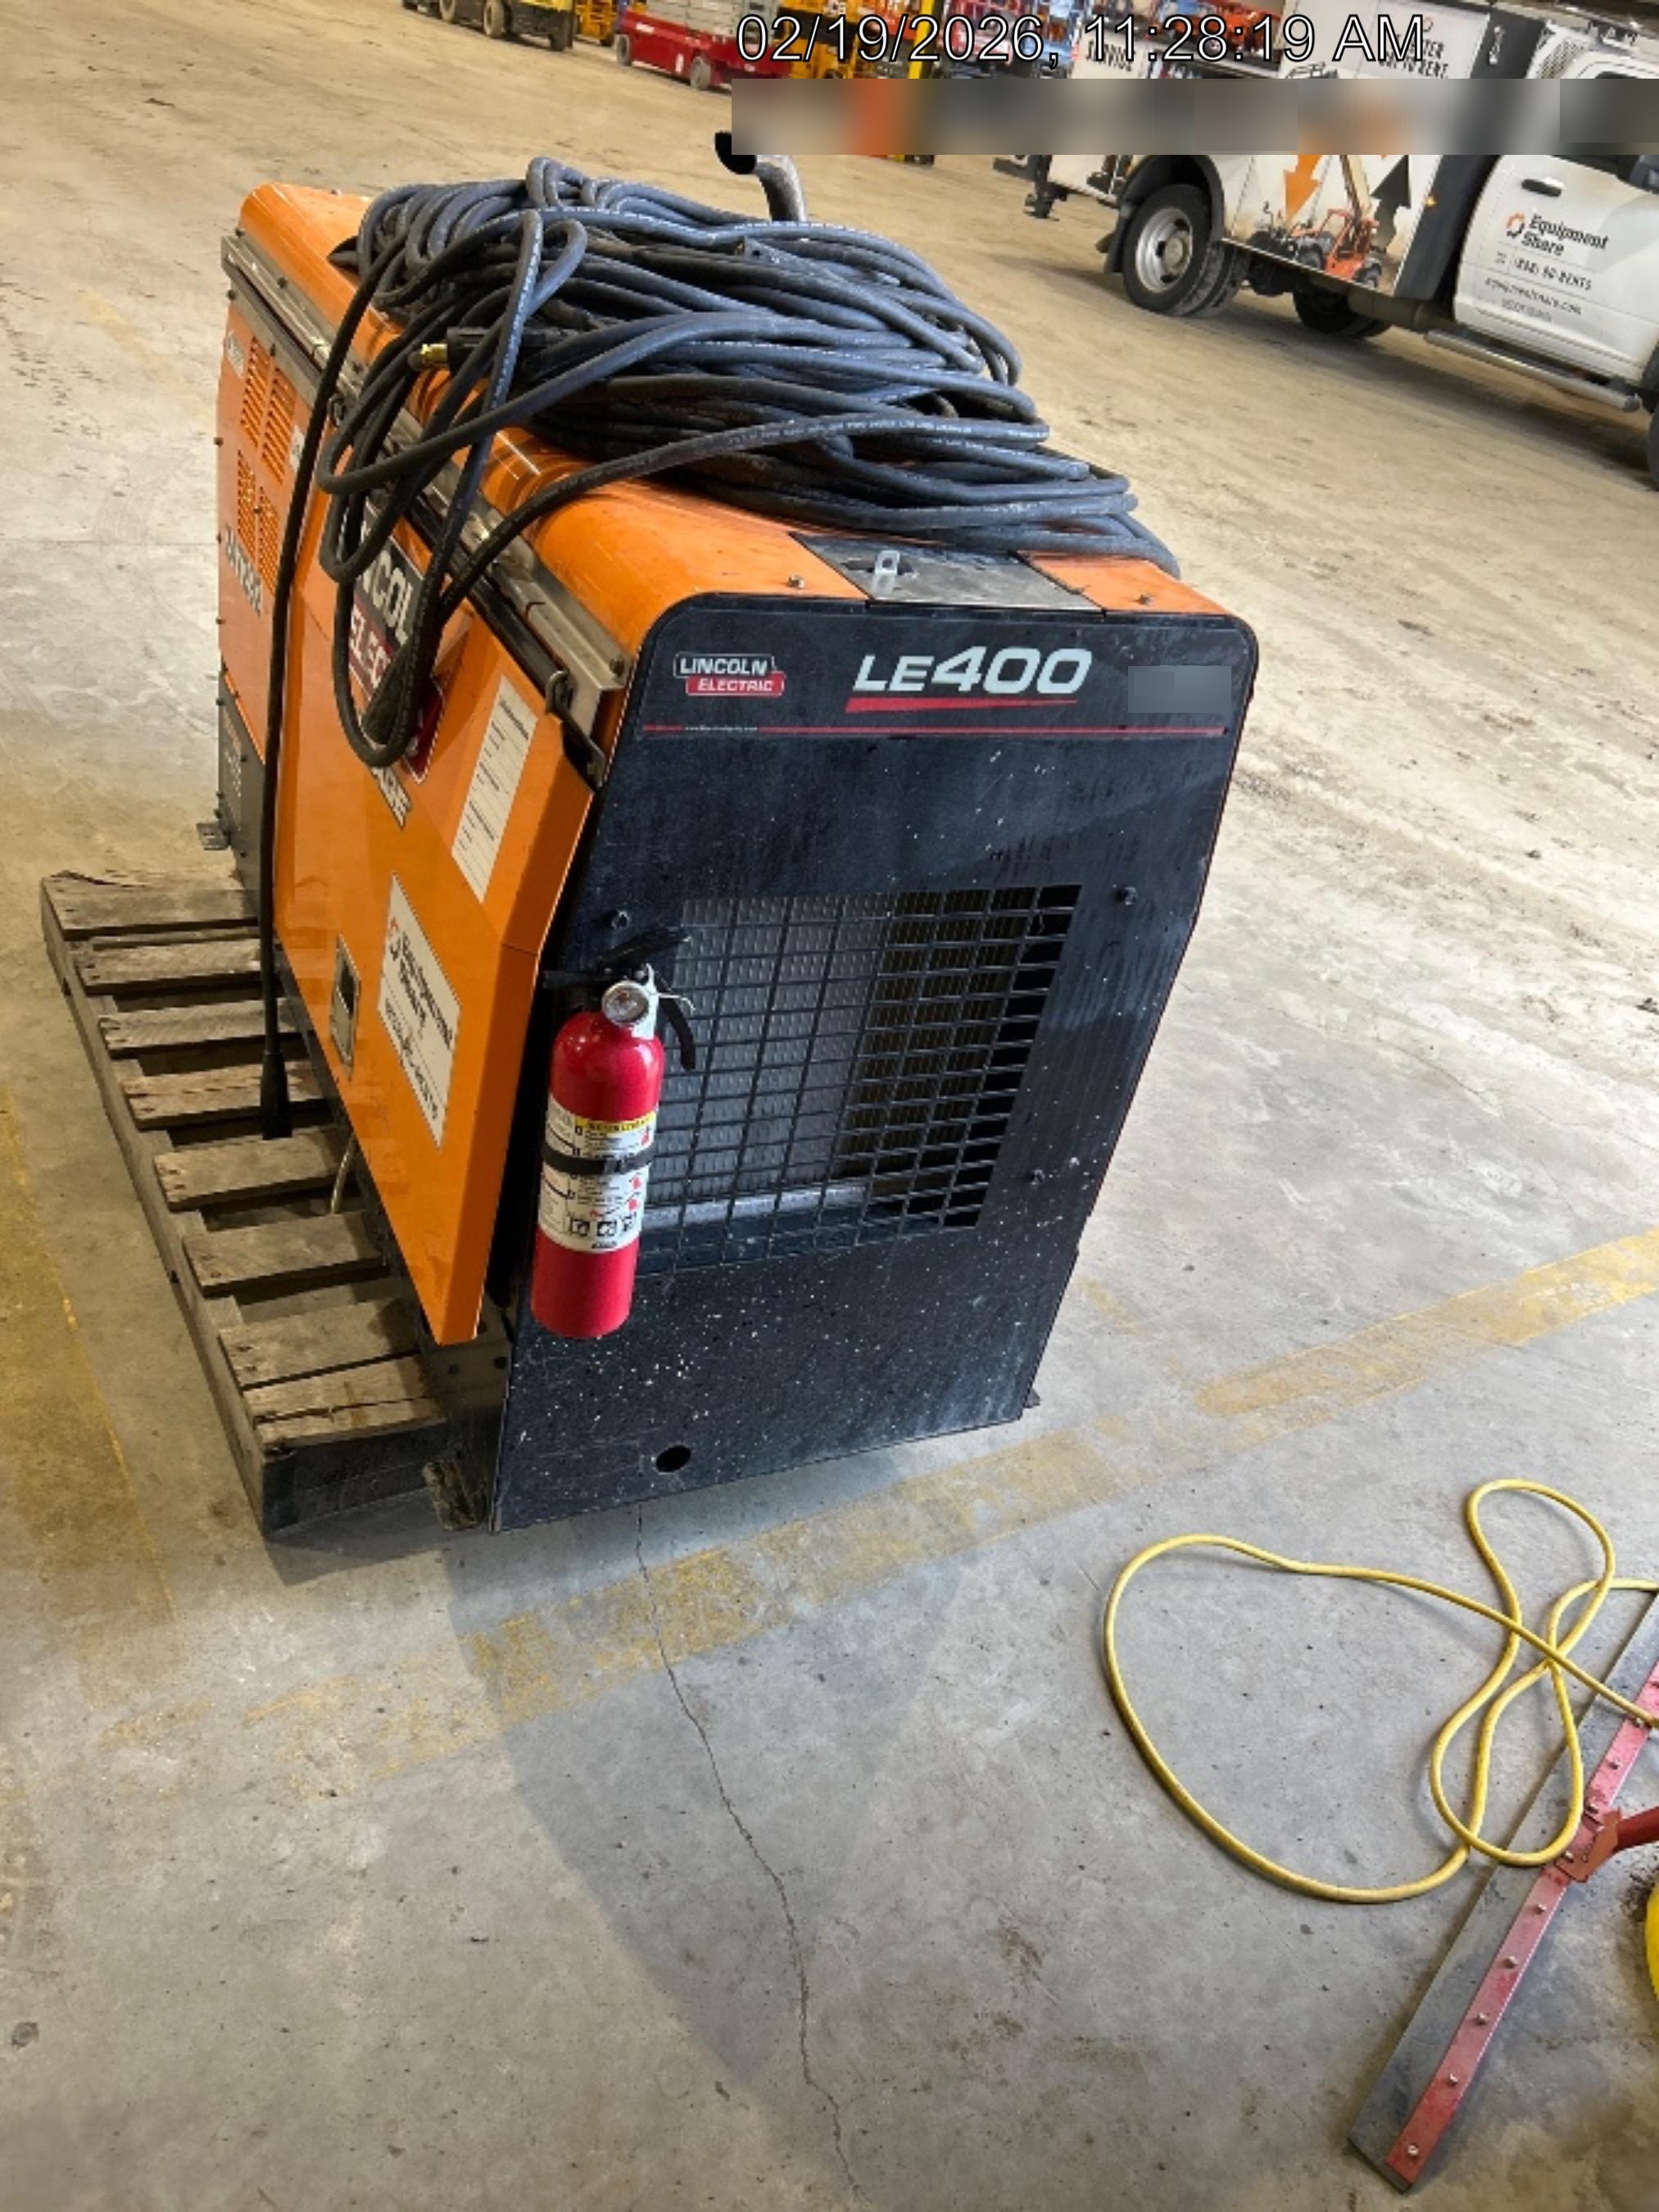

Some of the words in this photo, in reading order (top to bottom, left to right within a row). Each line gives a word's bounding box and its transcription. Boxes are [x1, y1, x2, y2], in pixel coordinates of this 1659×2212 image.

[1521, 231, 1564, 256] Share
[1530, 214, 1608, 249] Equipment
[679, 657, 768, 676] LINCOLN
[852, 646, 1093, 694] LE400
[696, 678, 774, 691] ELECTRIC
